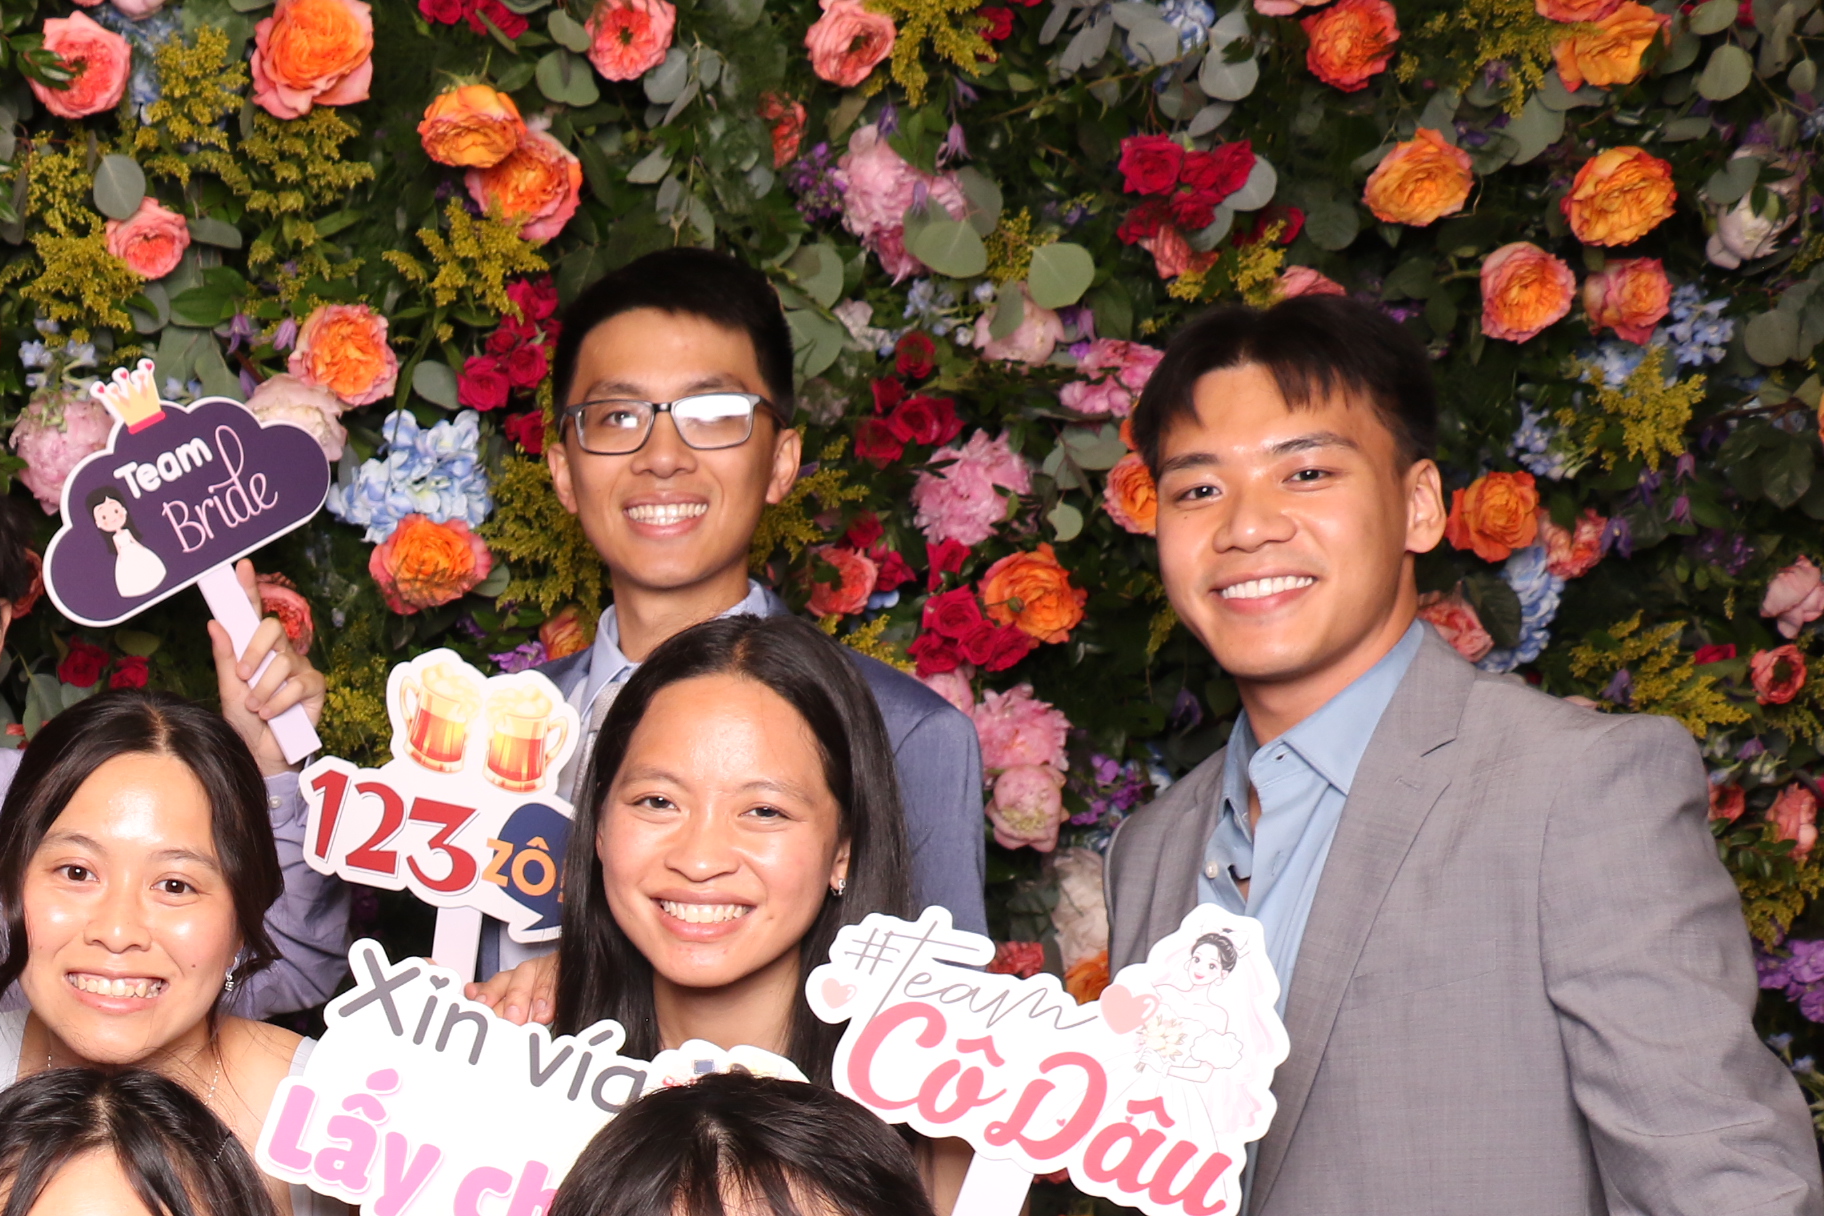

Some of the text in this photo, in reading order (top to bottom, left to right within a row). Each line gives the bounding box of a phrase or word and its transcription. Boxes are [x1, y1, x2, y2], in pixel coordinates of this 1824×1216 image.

[113, 437, 213, 499] Team
[161, 424, 278, 553] Bride
[311, 769, 480, 893] 123
[337, 948, 489, 1066] Xin
[844, 920, 1099, 1029] #Team
[847, 1001, 1008, 1125] Cô
